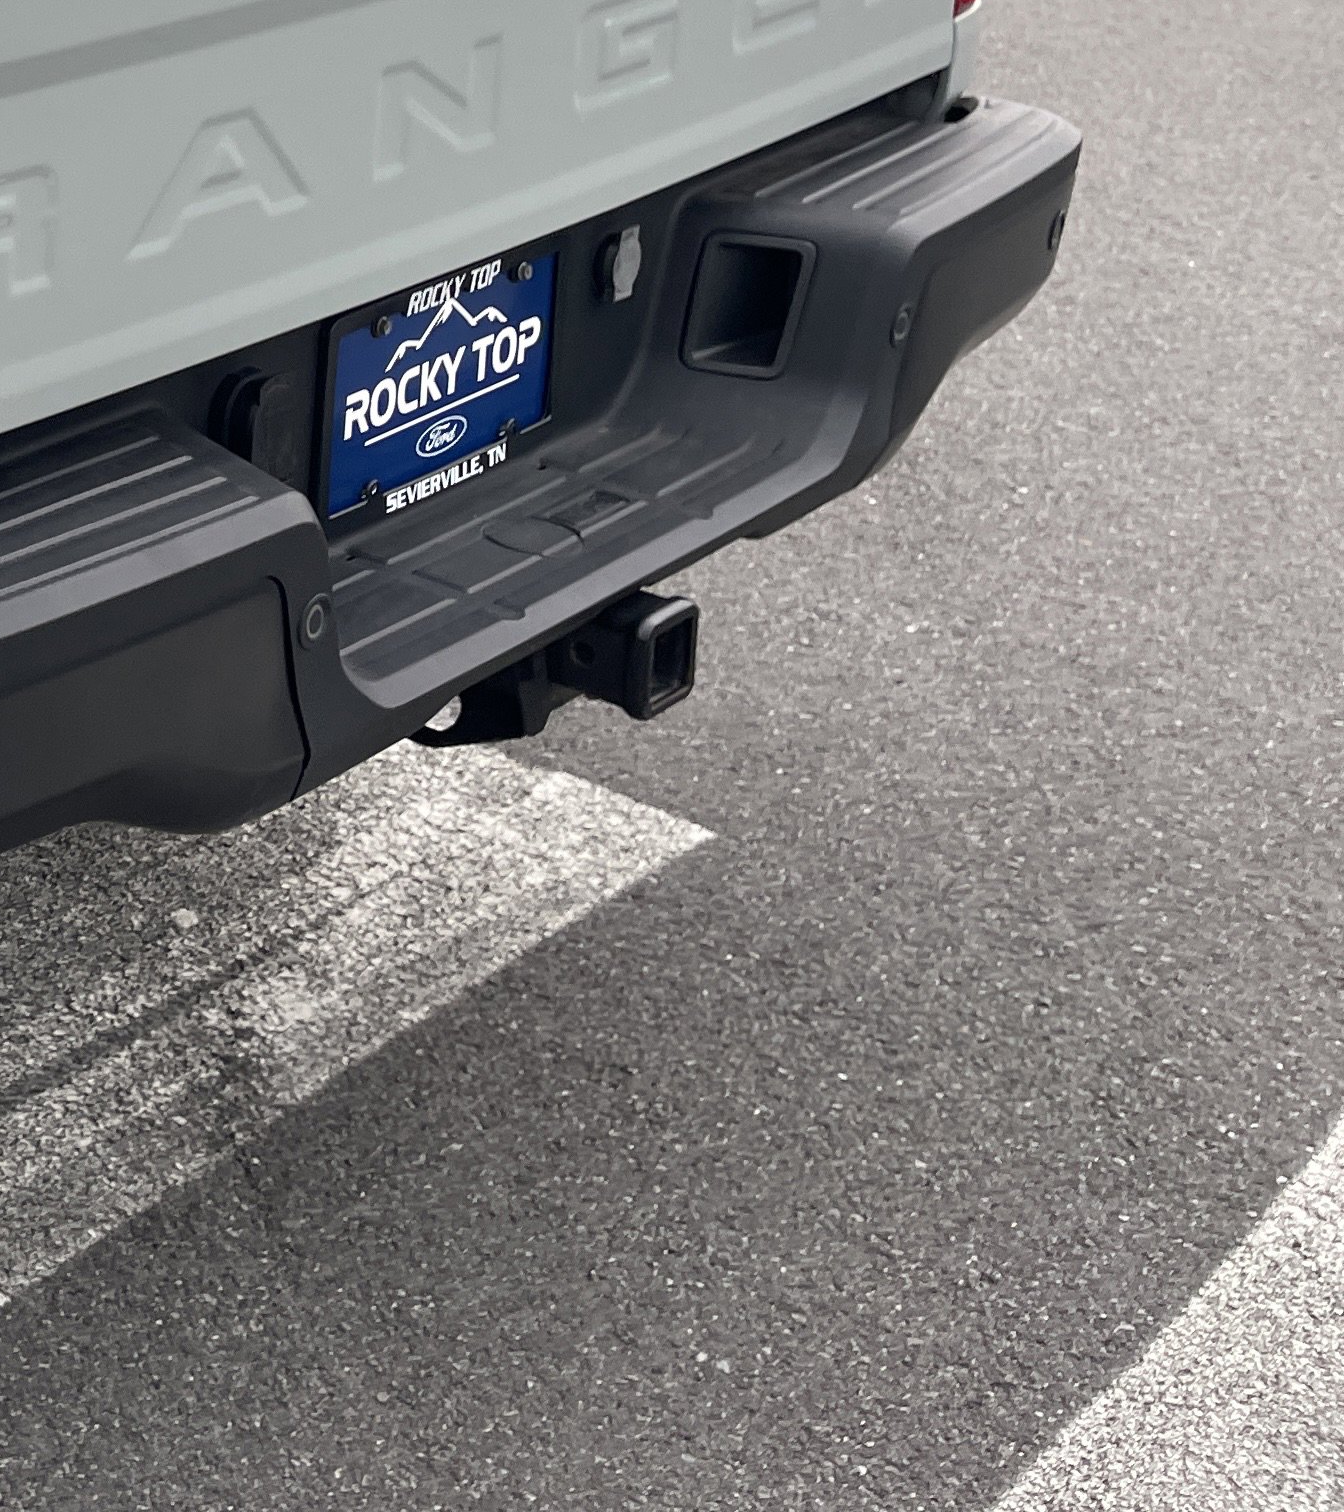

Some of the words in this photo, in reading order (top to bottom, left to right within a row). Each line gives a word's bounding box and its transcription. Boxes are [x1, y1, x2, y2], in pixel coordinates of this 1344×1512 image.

[406, 273, 466, 318] ROCKY
[468, 258, 502, 293] TOP
[343, 345, 467, 441] ROCKY
[471, 315, 542, 382] TOP
[425, 421, 459, 451] Ford
[385, 453, 485, 515] SEVIERVILLE,
[487, 441, 508, 468] TN
